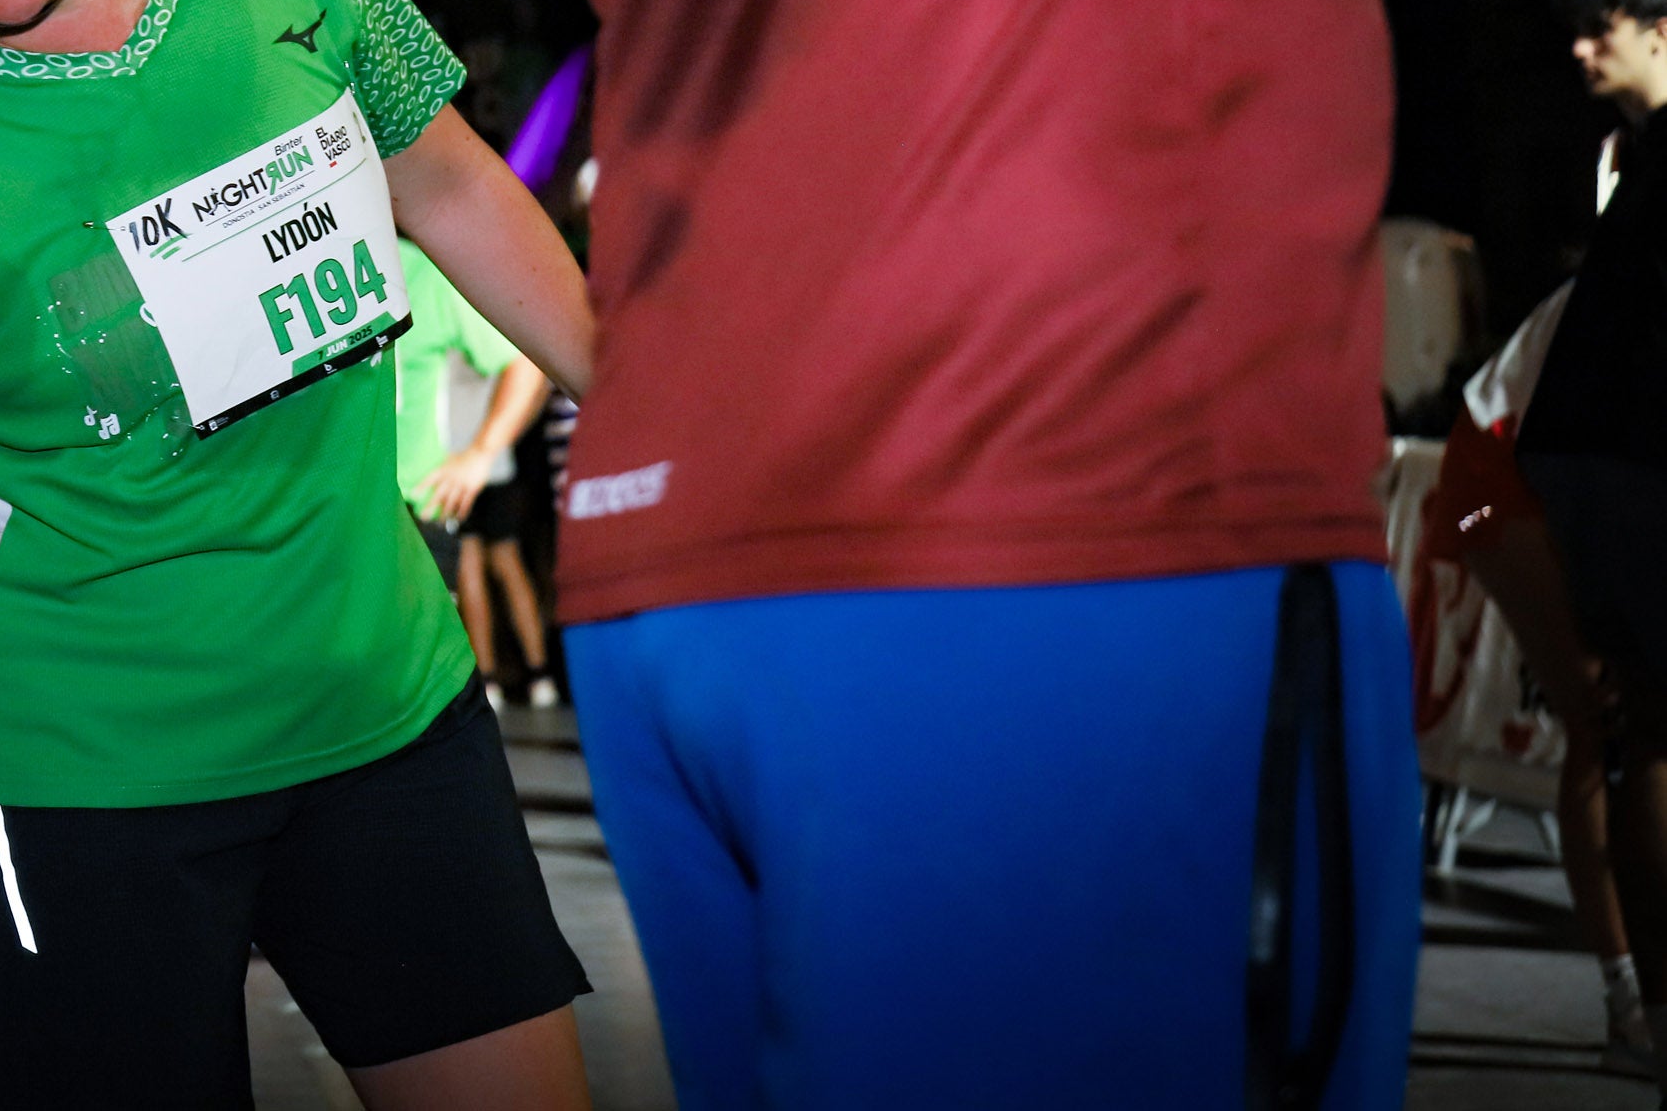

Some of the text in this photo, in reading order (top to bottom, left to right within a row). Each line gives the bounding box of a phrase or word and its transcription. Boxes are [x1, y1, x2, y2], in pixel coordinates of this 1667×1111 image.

[275, 136, 304, 157] Binter
[316, 127, 328, 139] EL
[320, 126, 348, 151] DIARIO
[325, 138, 352, 162] VASCO
[129, 198, 188, 254] 10K
[262, 202, 338, 263] LYDÓN
[258, 239, 387, 356] F194
[326, 340, 348, 357] JUN
[349, 325, 373, 345] 2025
